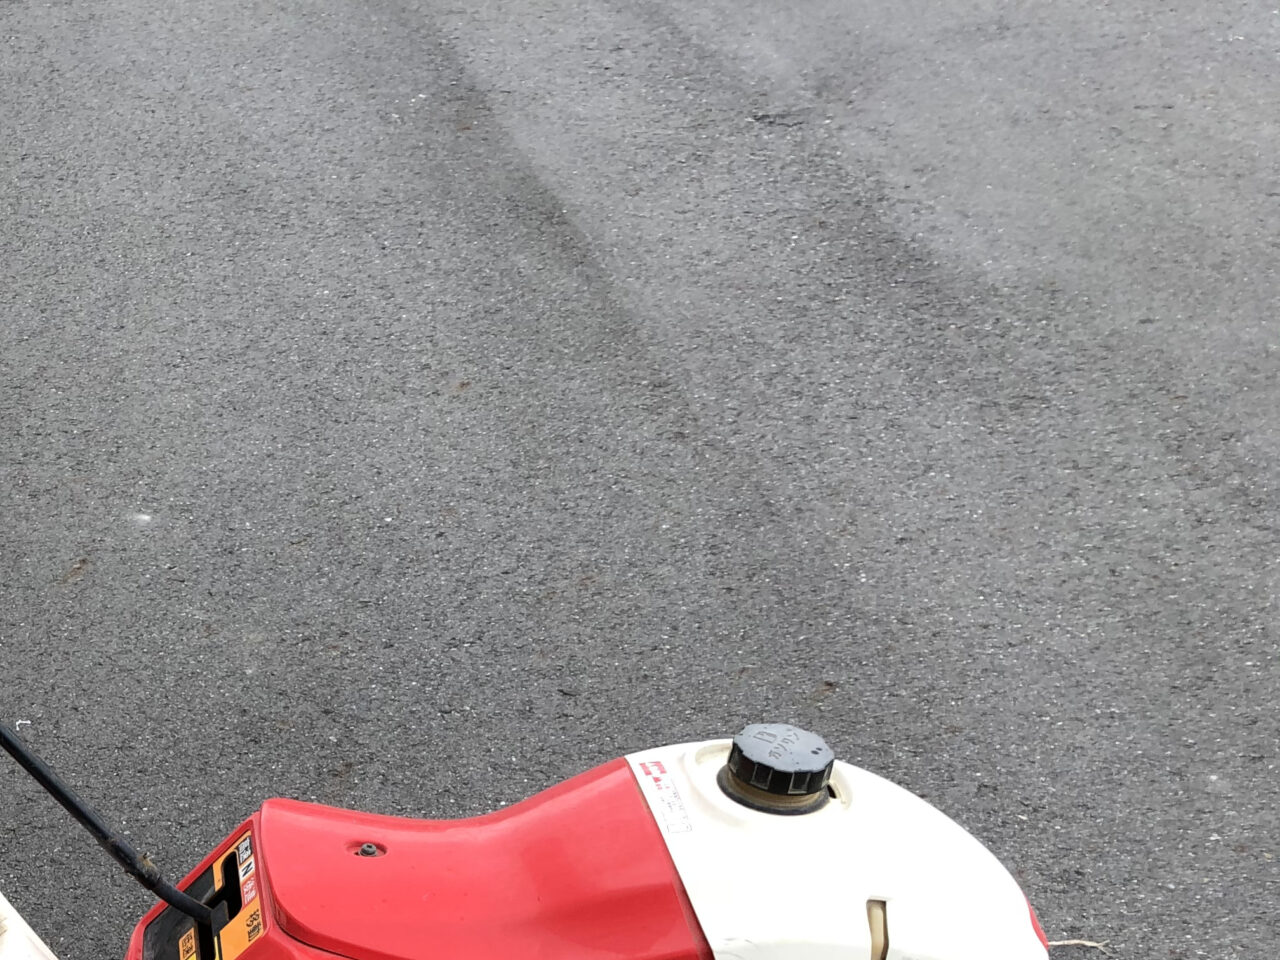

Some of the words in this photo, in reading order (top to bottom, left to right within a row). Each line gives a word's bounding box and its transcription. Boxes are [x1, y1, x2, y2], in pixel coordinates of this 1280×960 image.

[768, 731, 800, 760] ガソリン
[242, 862, 253, 876] N
[246, 909, 261, 943] 移動
